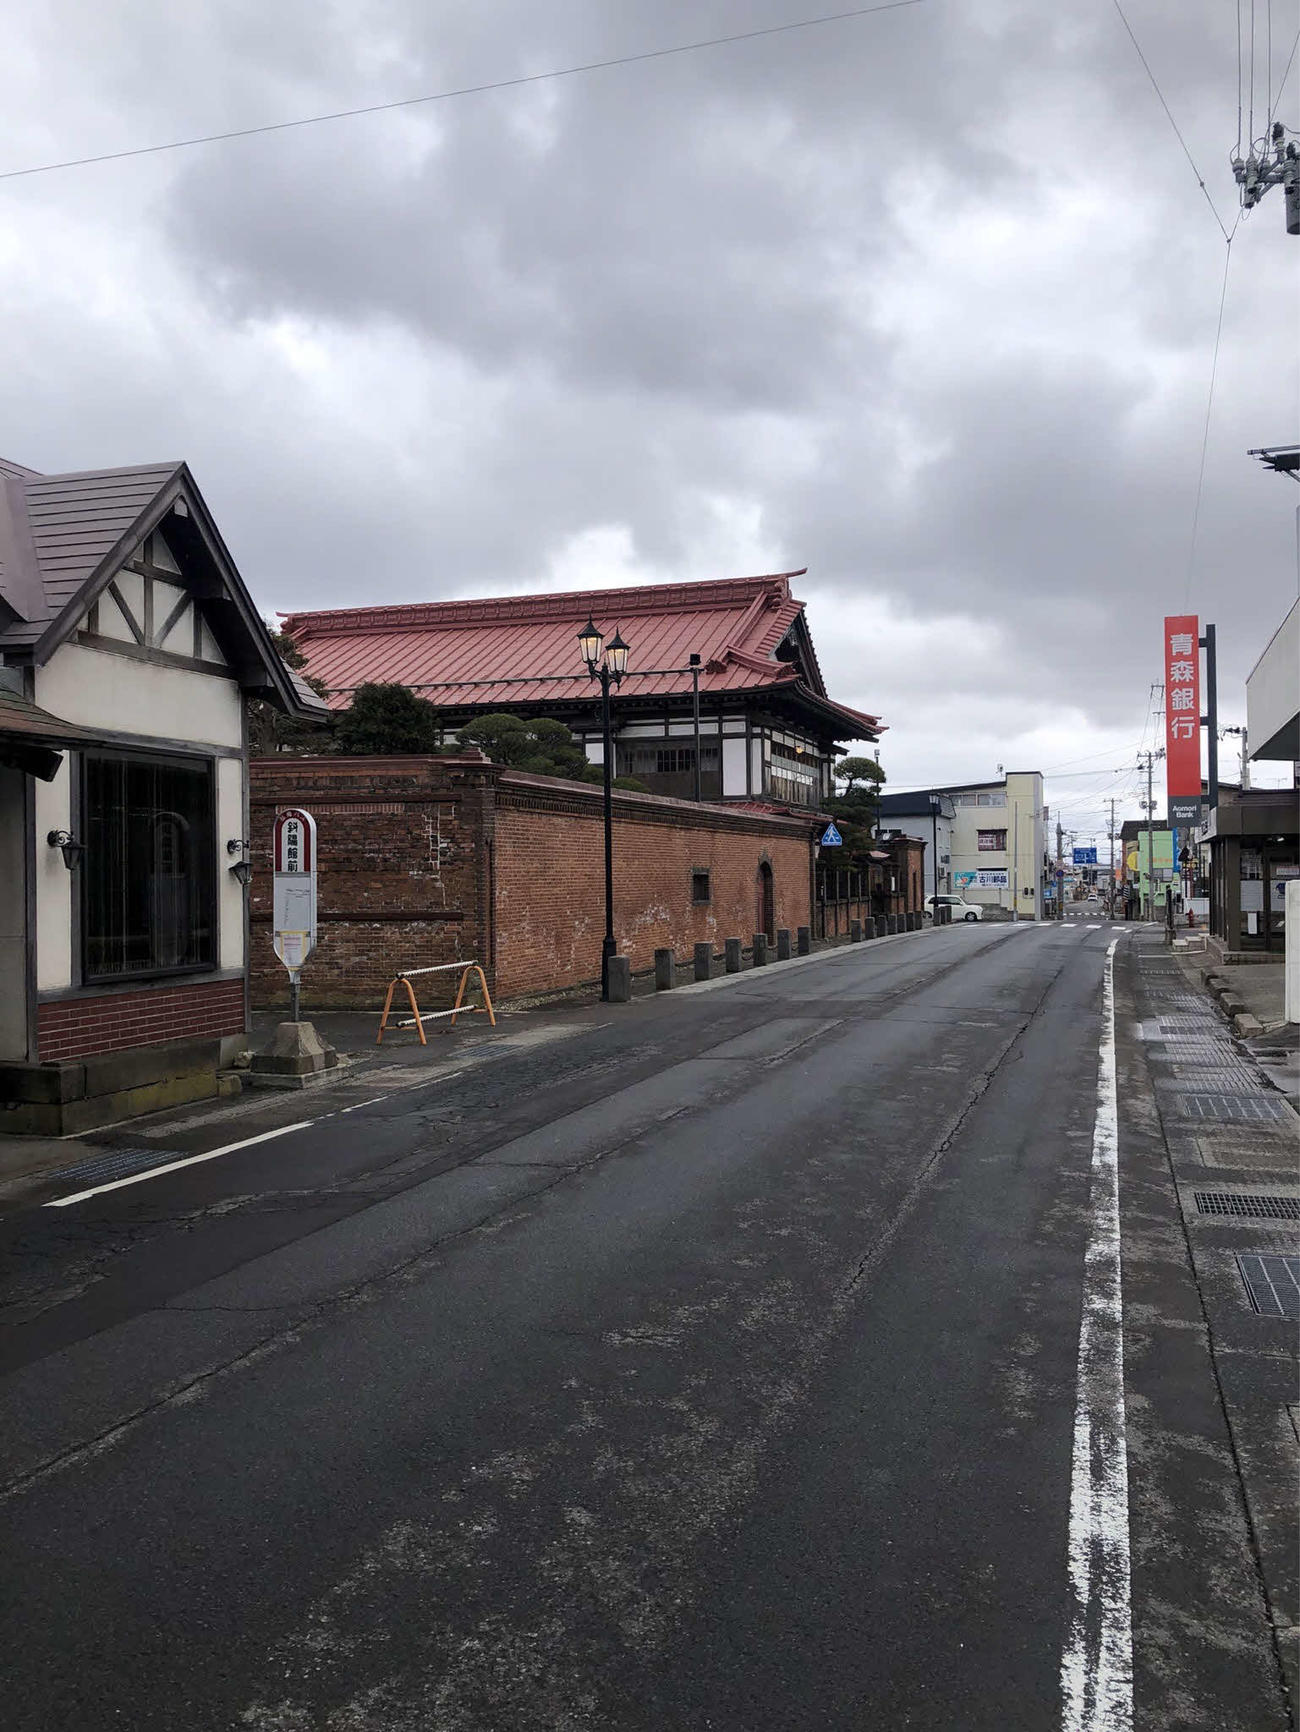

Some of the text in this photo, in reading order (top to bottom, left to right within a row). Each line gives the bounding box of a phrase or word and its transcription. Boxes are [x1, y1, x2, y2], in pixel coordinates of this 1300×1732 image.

[1169, 633, 1195, 739] 青森銀行
[1172, 804, 1197, 812] Aomori
[1176, 811, 1194, 819] Bank
[287, 821, 298, 872] 斜陽館前
